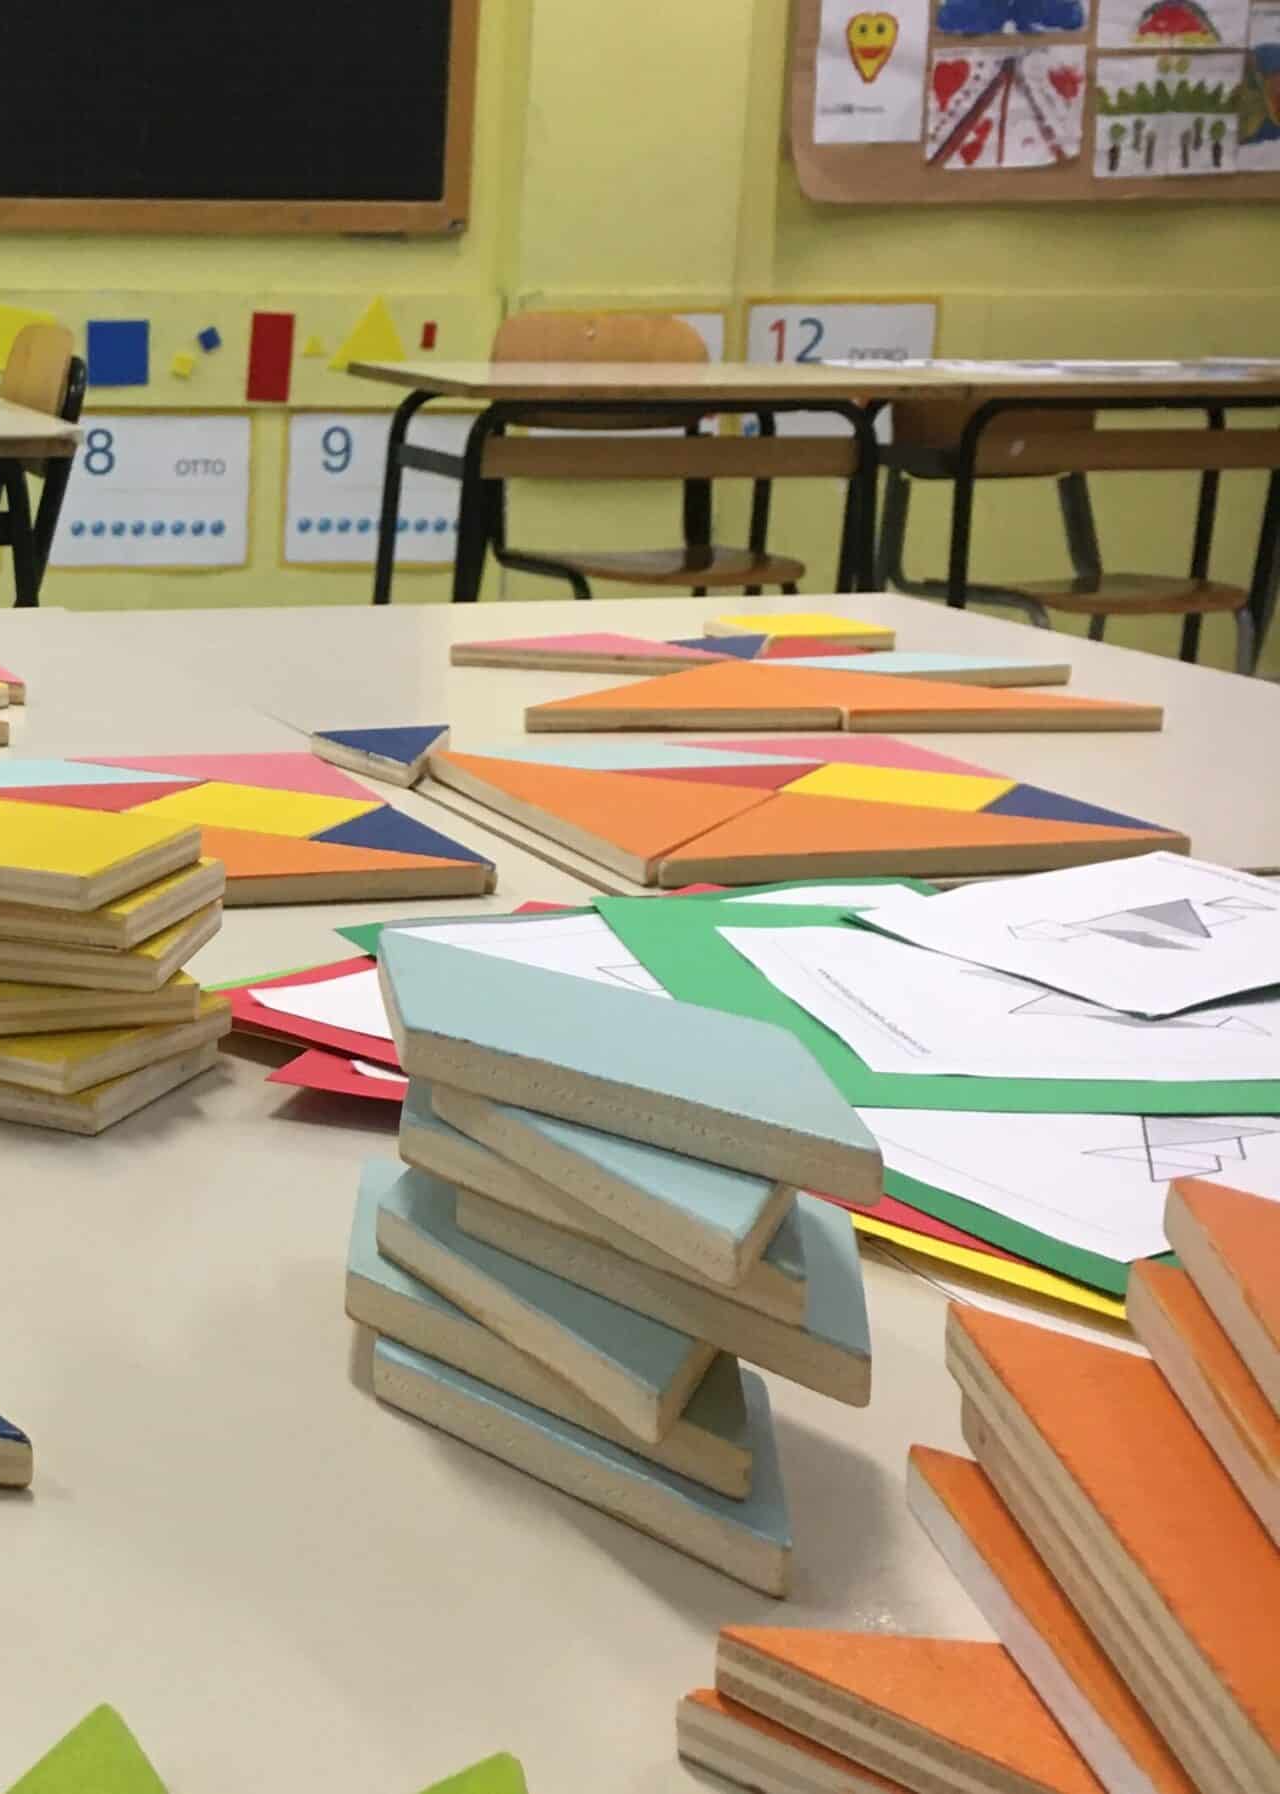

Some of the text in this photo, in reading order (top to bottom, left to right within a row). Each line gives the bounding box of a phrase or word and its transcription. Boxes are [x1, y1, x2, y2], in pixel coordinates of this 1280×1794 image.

[768, 317, 824, 363] 12
[84, 428, 115, 476] 8
[175, 458, 227, 477] OTTO
[321, 426, 353, 474] 9
